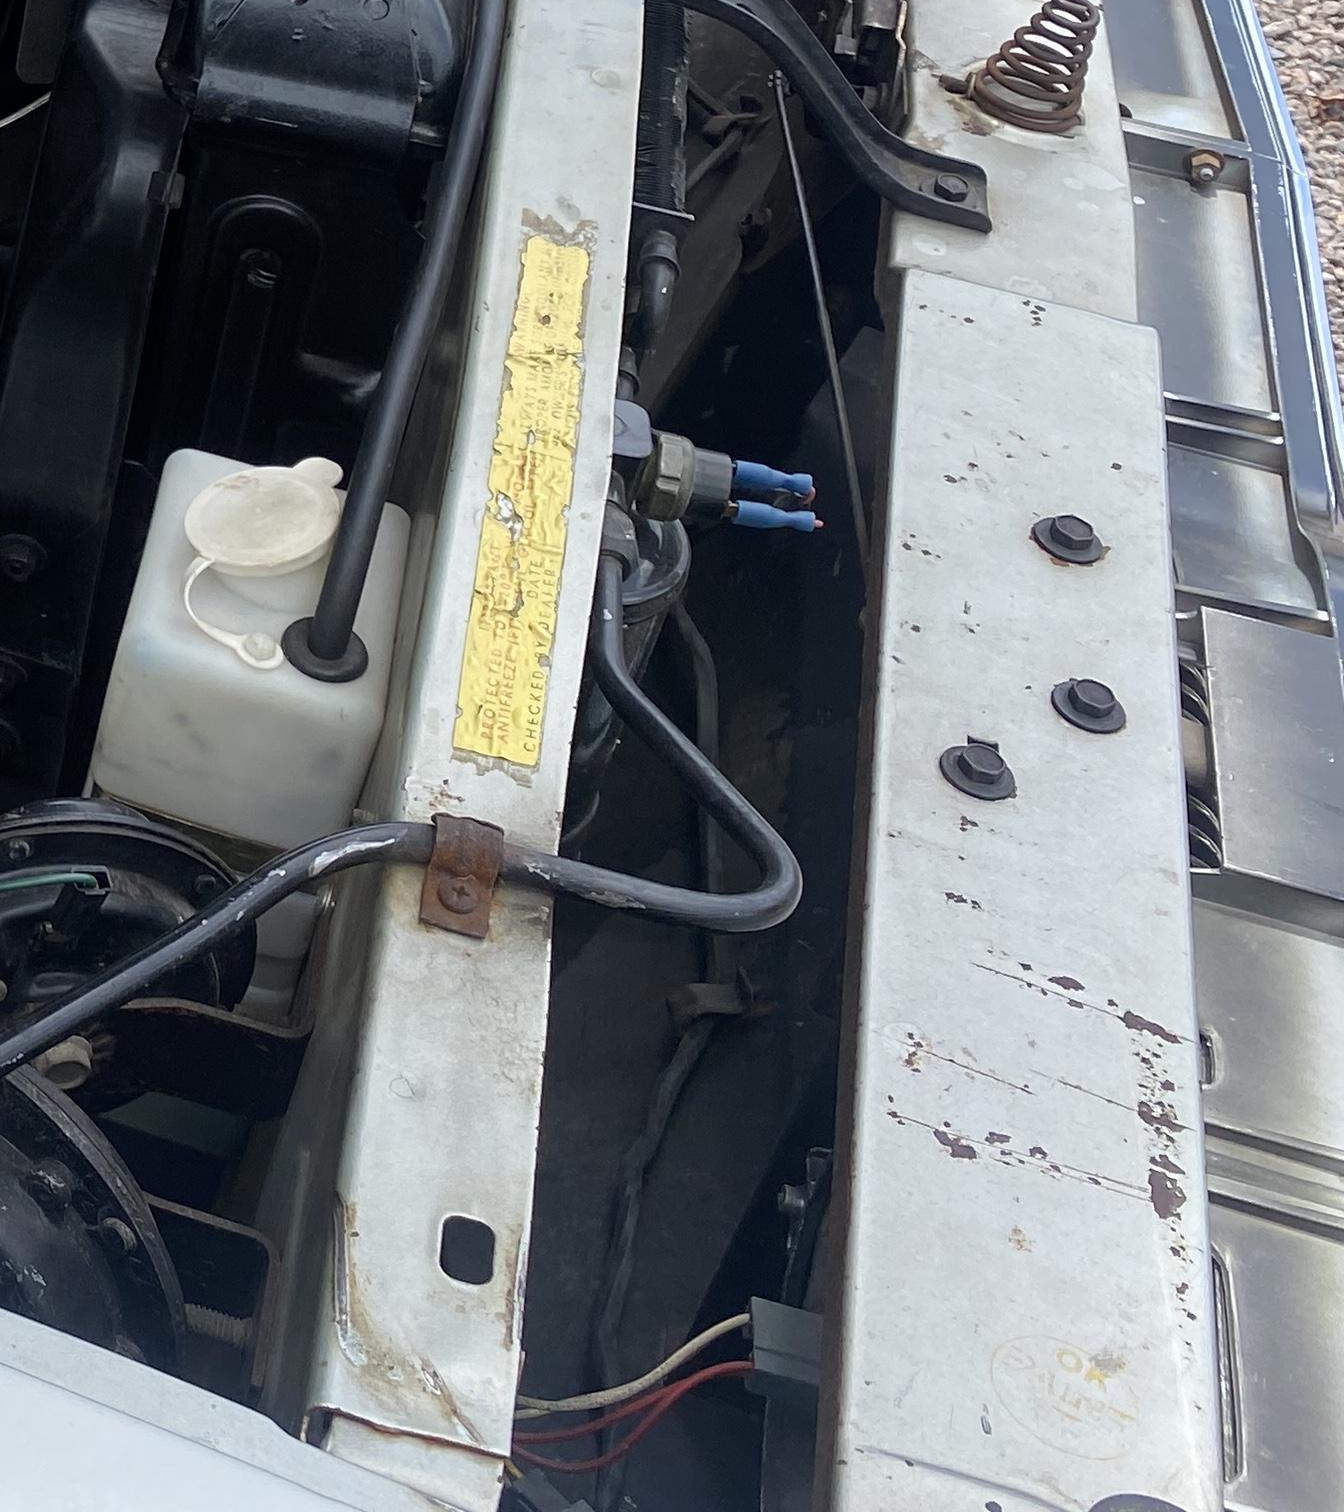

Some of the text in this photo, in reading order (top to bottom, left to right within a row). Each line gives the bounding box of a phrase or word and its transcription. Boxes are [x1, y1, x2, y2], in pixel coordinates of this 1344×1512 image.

[525, 559, 543, 599] DATE
[491, 618, 506, 641] TO
[479, 647, 504, 740] PROTECTED
[494, 655, 518, 744] ANTIFREEZE
[522, 669, 545, 752] CHECKED
